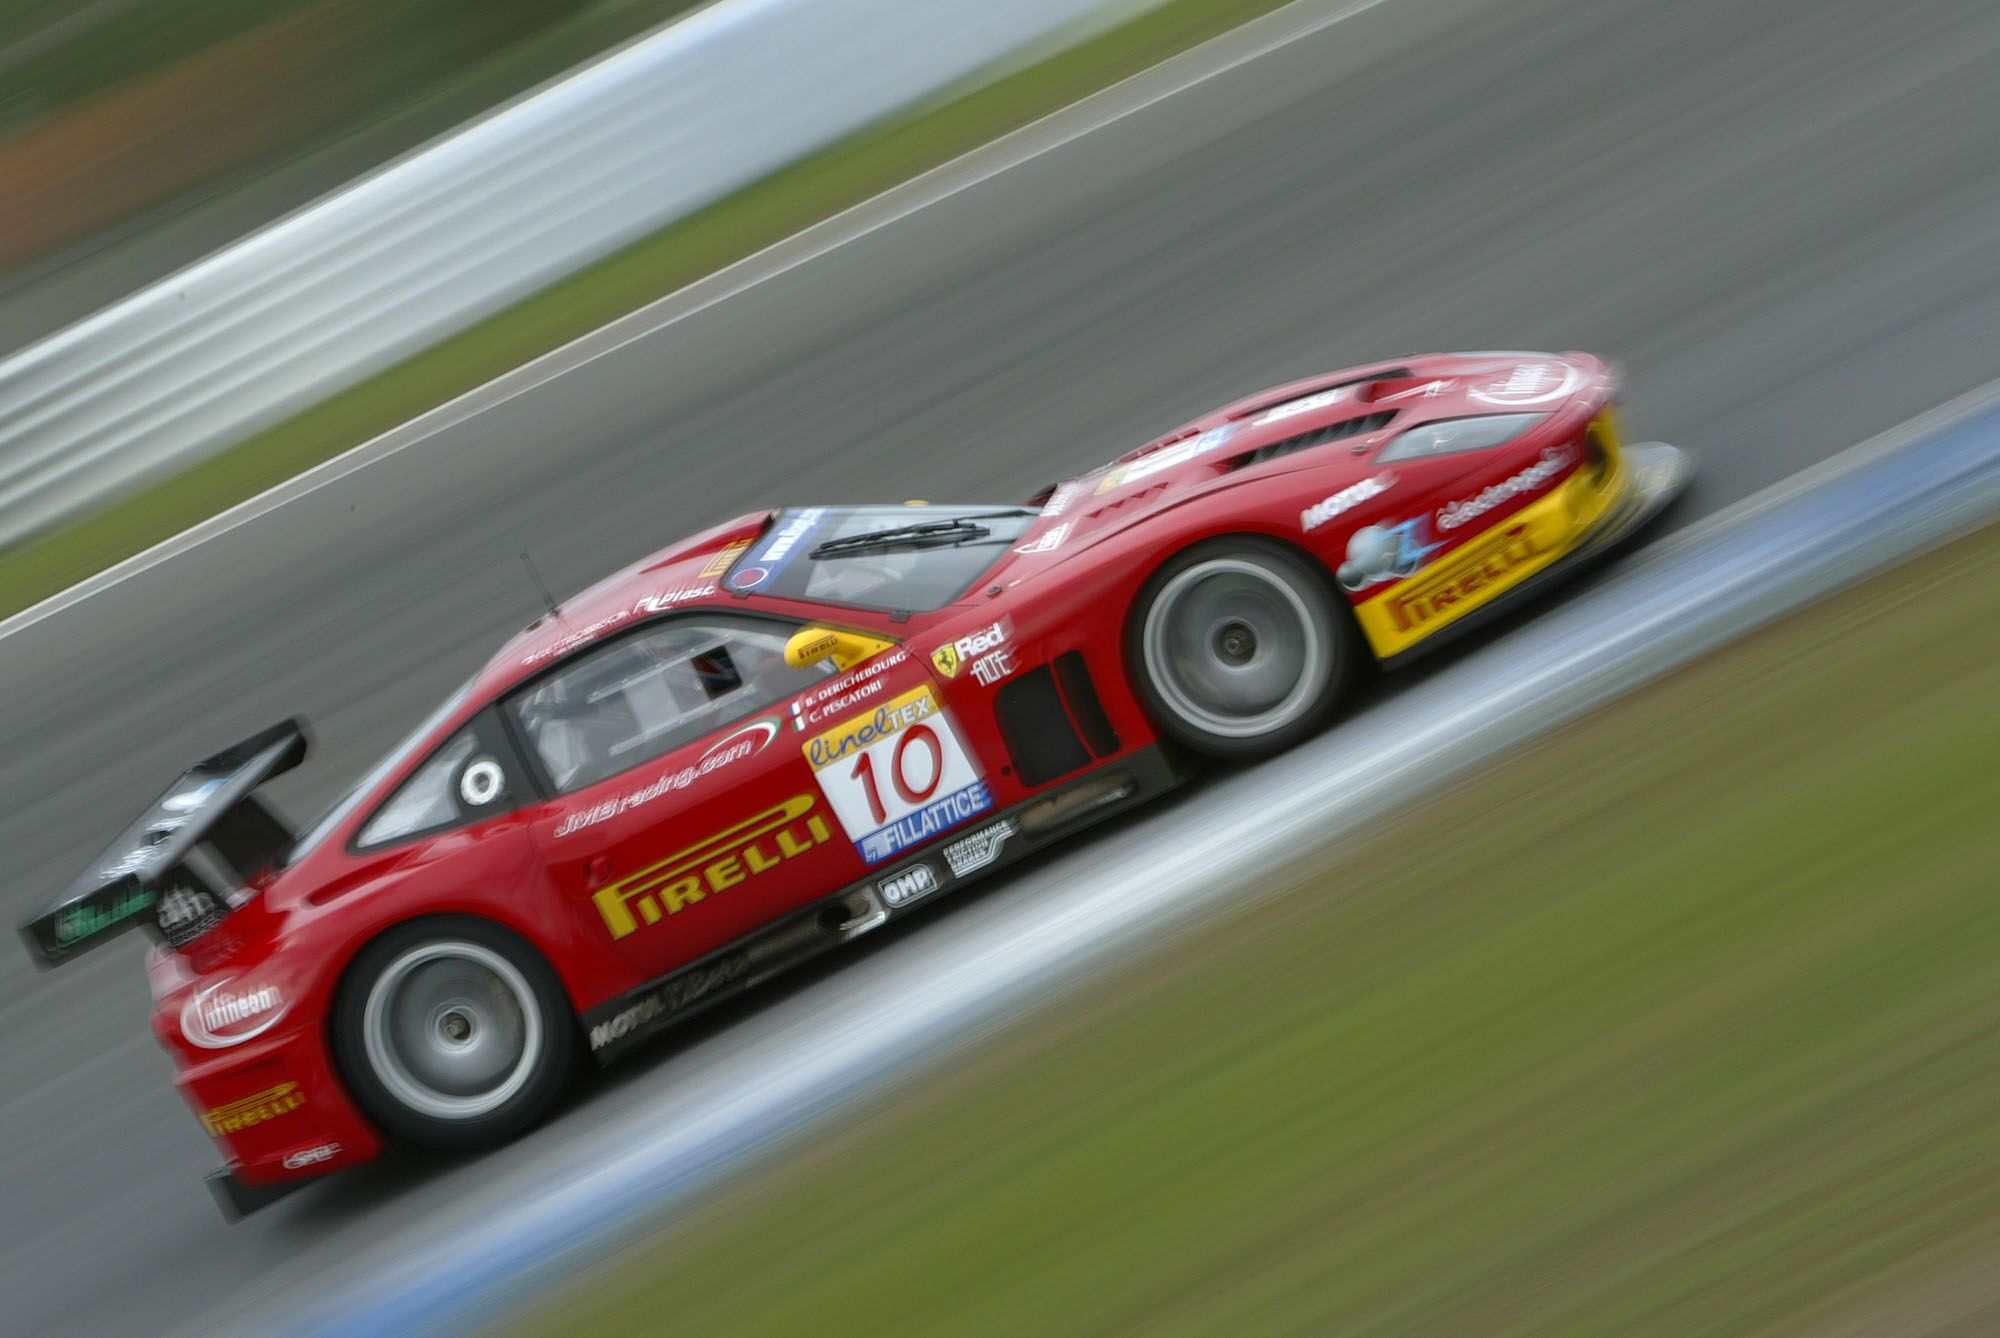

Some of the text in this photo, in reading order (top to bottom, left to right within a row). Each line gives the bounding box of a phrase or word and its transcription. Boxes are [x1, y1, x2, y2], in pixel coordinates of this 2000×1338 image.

[953, 622, 1005, 662] Red
[809, 680, 882, 723] C. PESCATORI
[818, 650, 906, 701] DERICHEBOURG
[850, 724, 943, 824] 10
[884, 783, 985, 852] FILLATTICE
[591, 793, 834, 941] PIRELLI
[884, 867, 931, 901] OMP
[202, 1081, 305, 1137] PIRELLI
